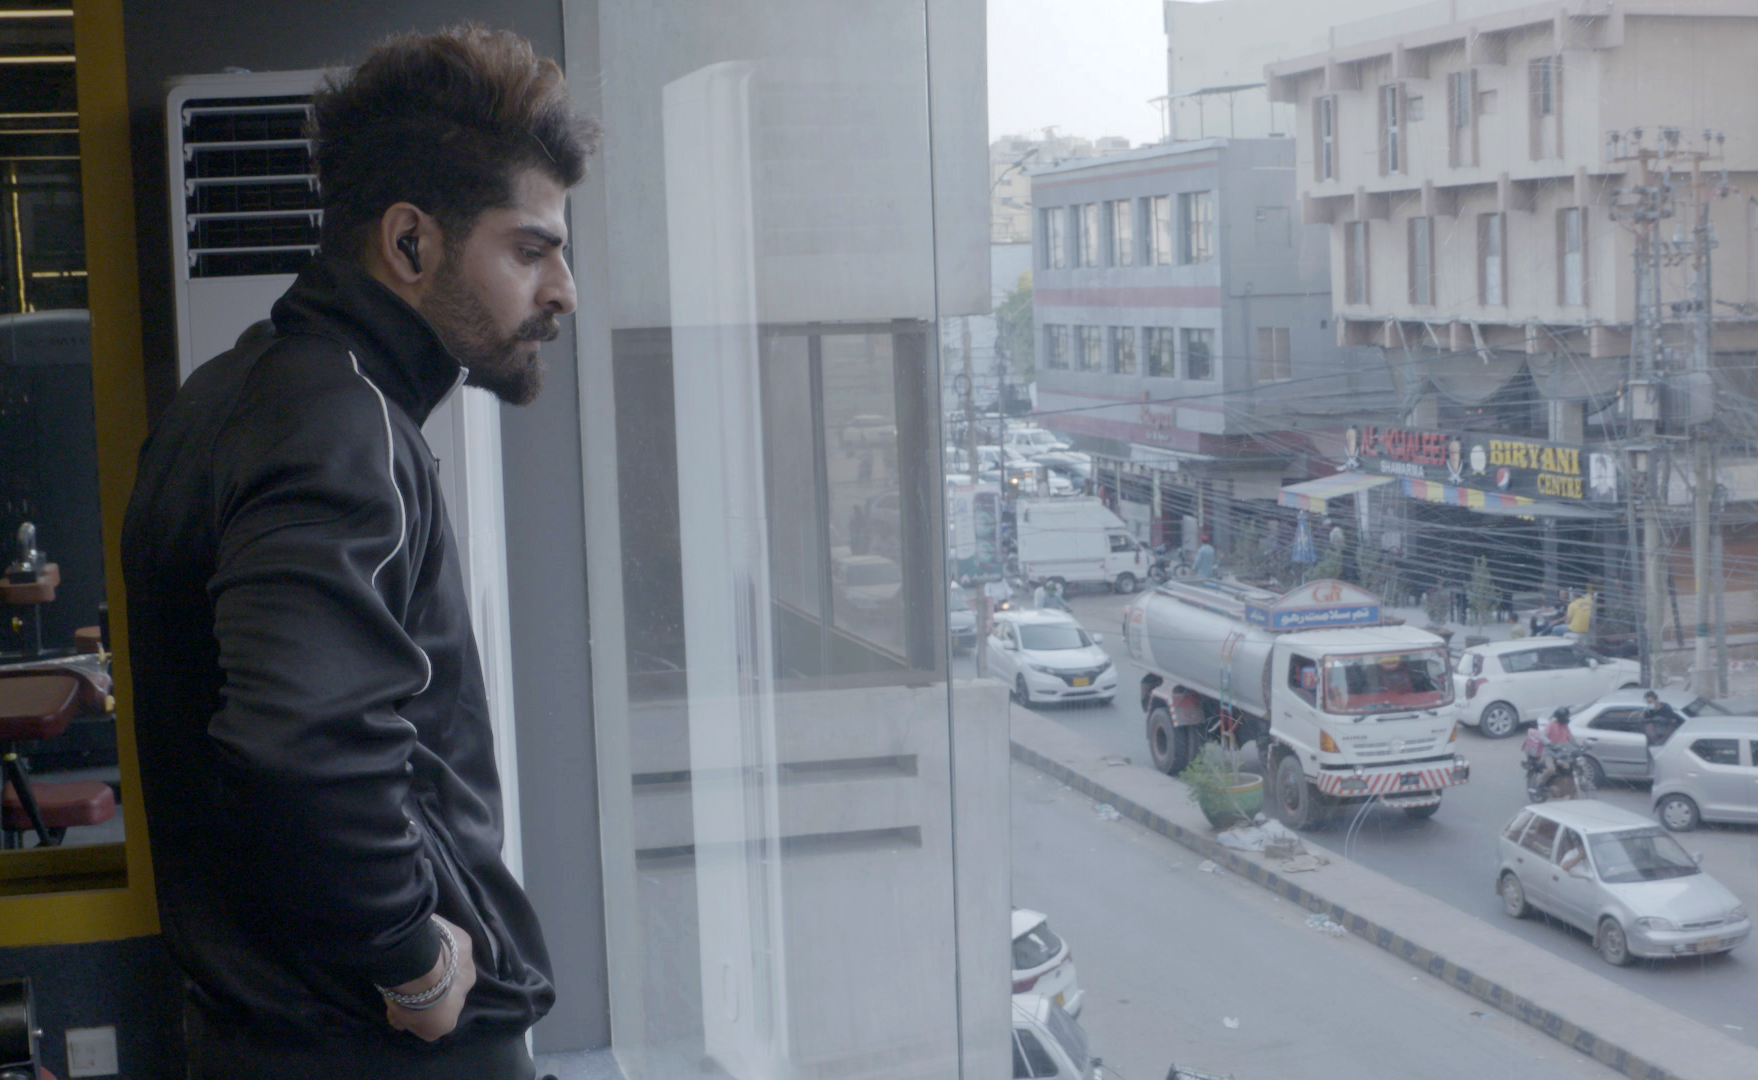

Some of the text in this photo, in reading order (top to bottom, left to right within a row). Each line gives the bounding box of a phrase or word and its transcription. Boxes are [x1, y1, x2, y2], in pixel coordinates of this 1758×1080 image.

[1380, 460, 1424, 478] SHAWARMA
[1489, 440, 1580, 475] BIRYANI
[1537, 473, 1583, 499] CENTRE
